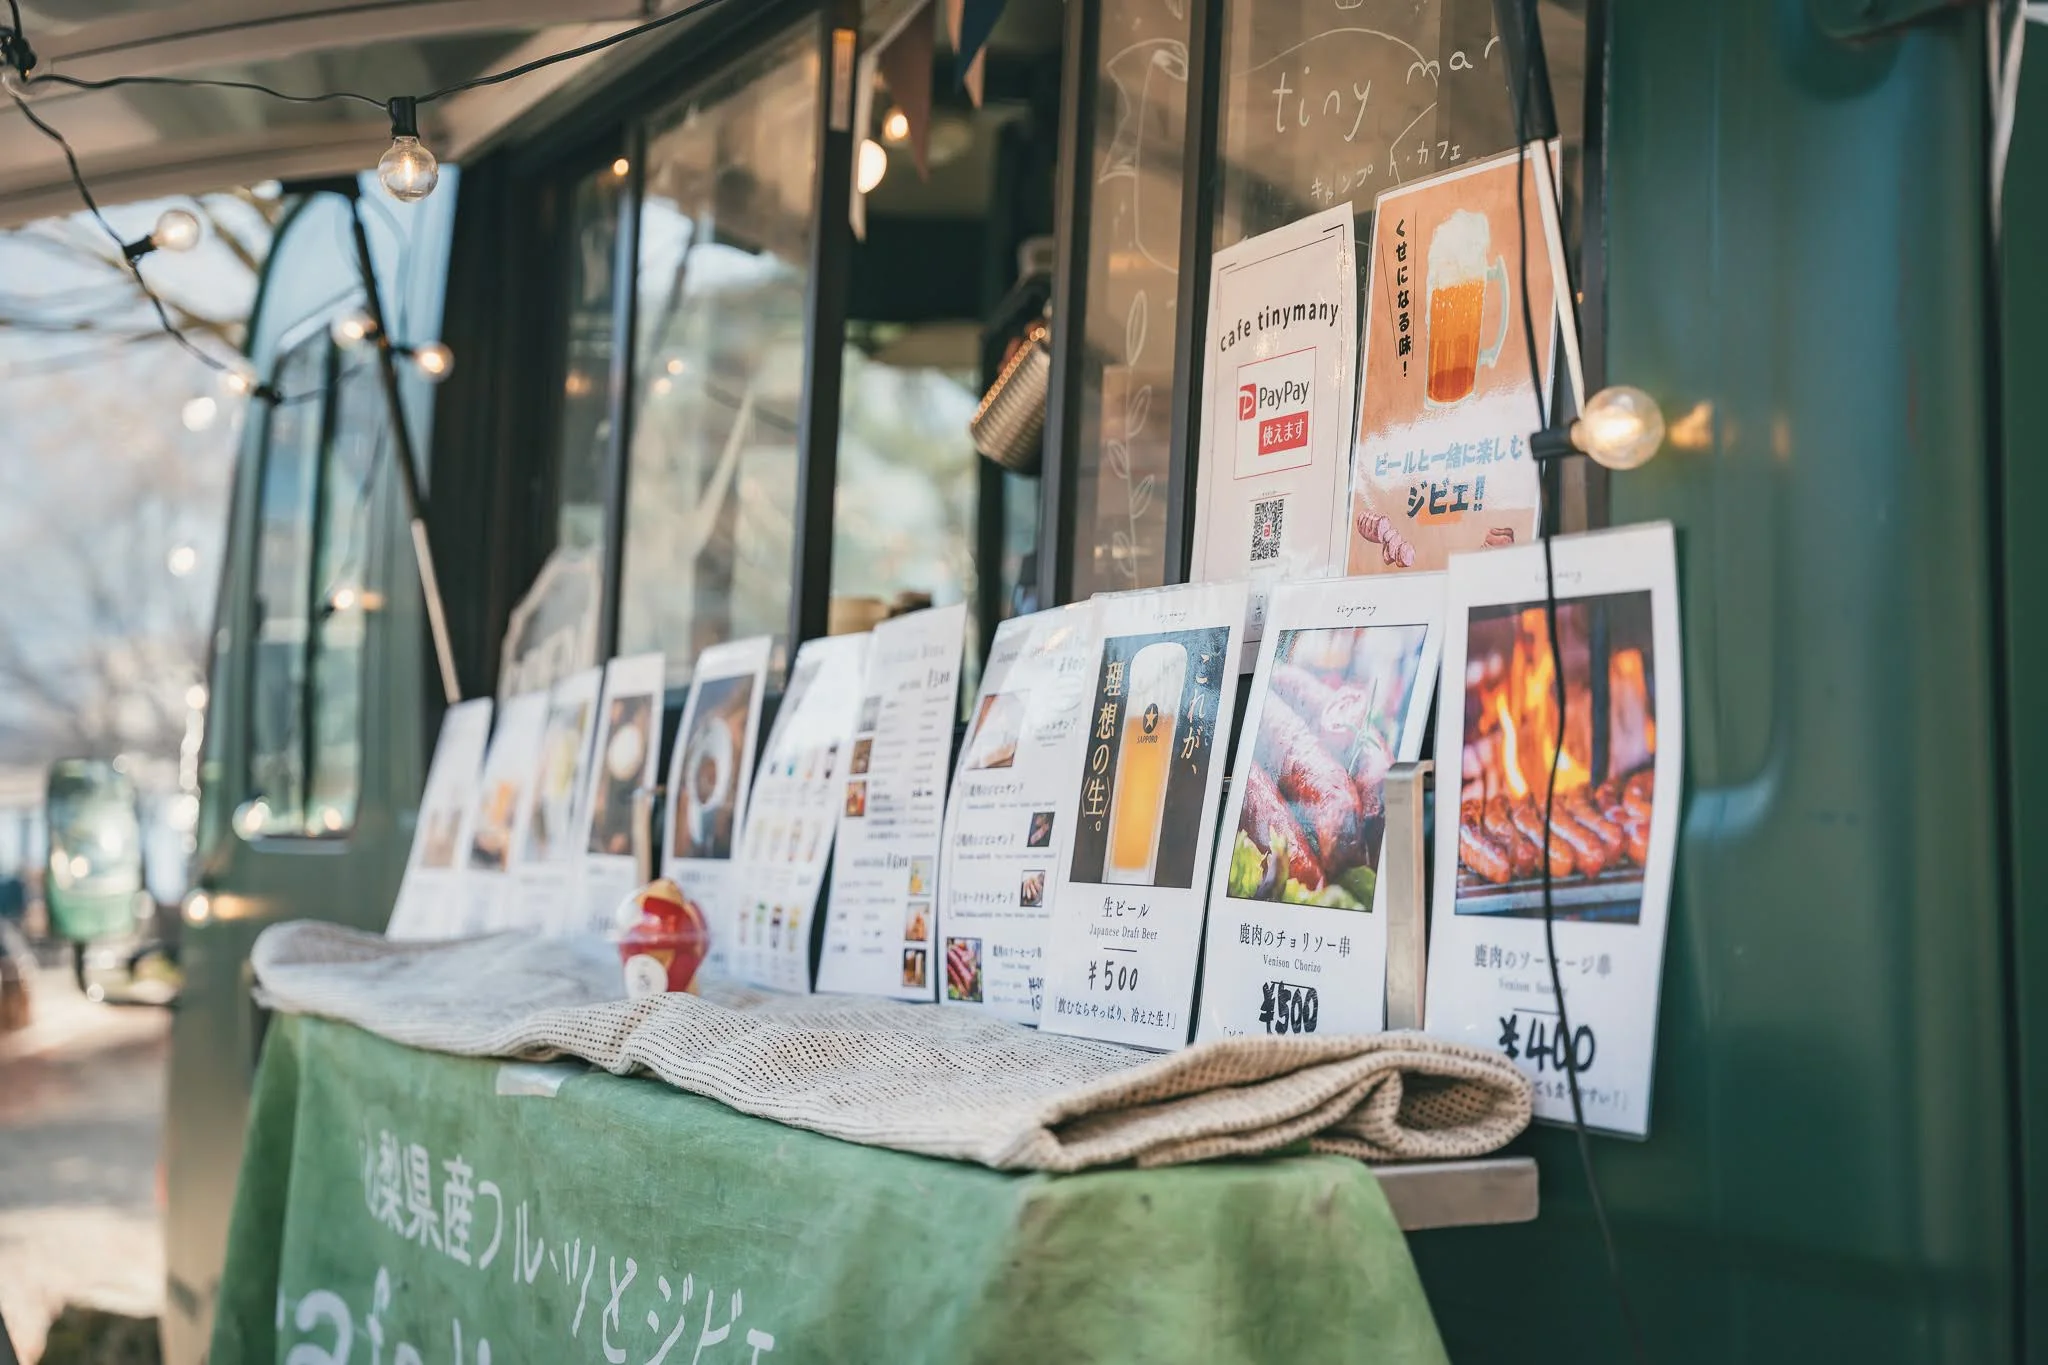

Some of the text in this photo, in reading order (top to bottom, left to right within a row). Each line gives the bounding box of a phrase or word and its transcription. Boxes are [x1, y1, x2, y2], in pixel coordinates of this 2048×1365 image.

[1272, 66, 1371, 142] tiny
[1395, 217, 1413, 379] くせになる味！
[1220, 301, 1340, 353] cafe tinymany
[1259, 379, 1310, 410] PayPay
[1263, 418, 1305, 447] 使えます
[1374, 433, 1525, 477] ビールと一緒に楽しむ
[1101, 896, 1150, 920] 生ビール
[1089, 923, 1158, 940] Japanese Draft Beer
[1239, 922, 1351, 958] 鹿肉のチョリソー串
[1088, 959, 1140, 992] ¥500
[1263, 954, 1322, 974] Venison Chorizo
[1498, 1014, 1596, 1073] ¥400
